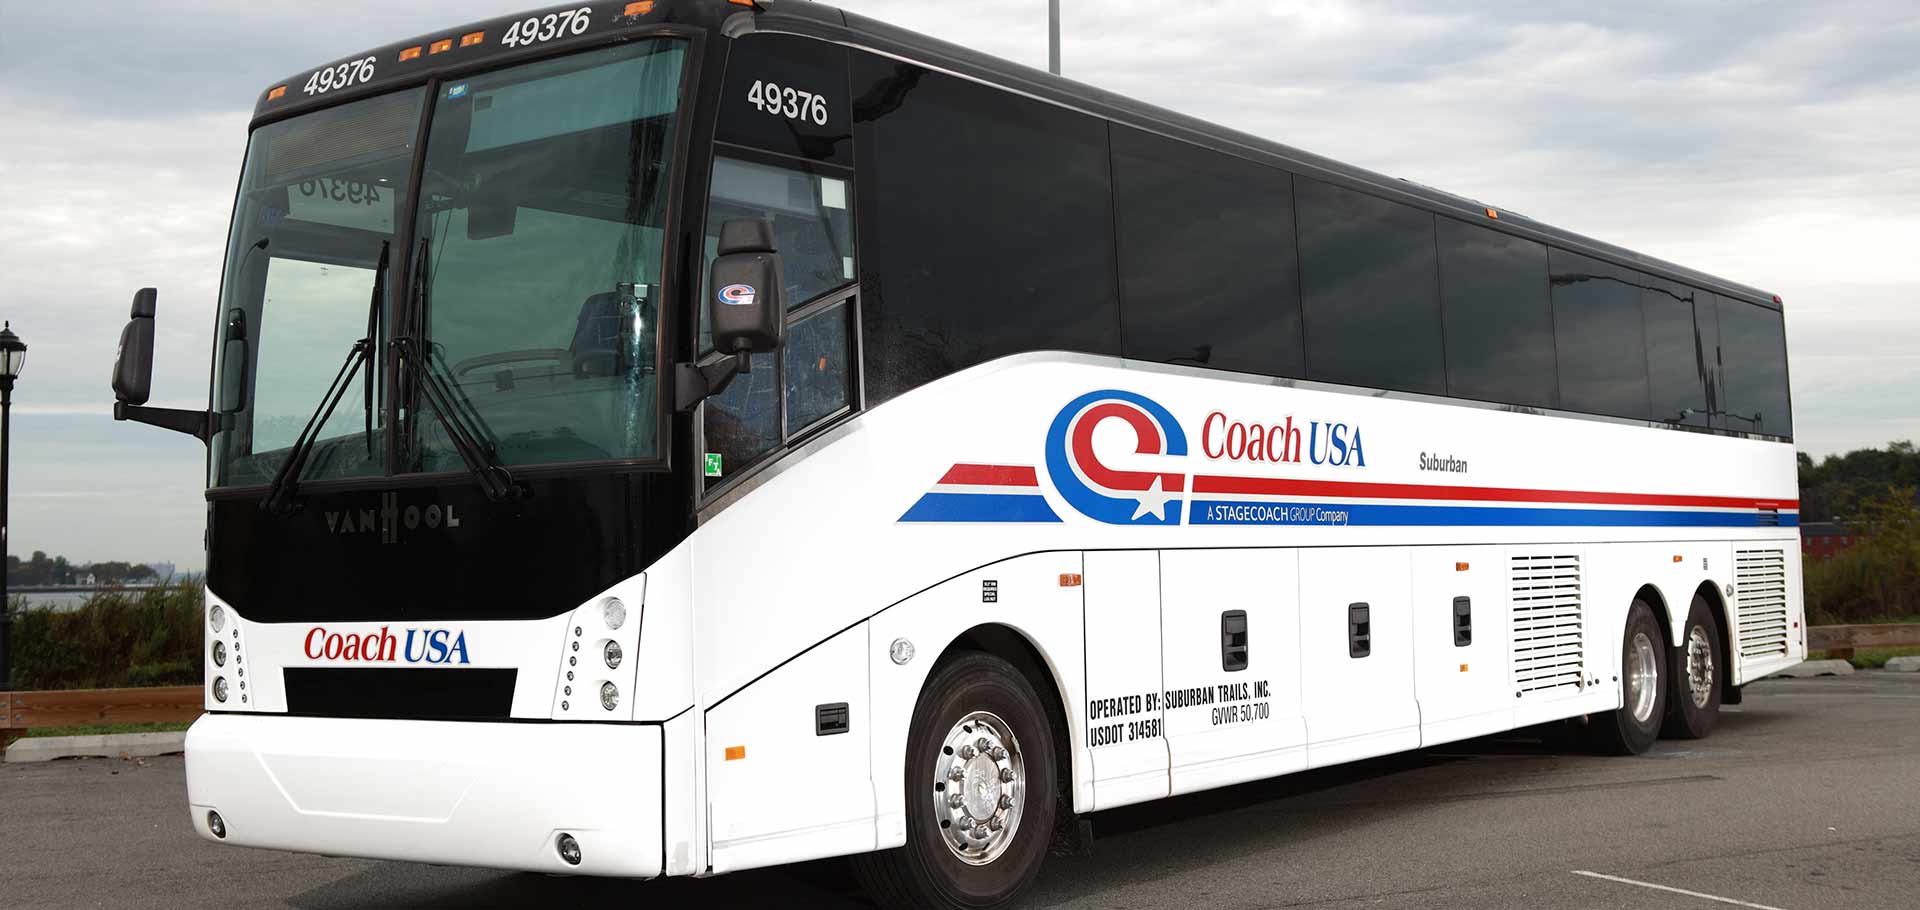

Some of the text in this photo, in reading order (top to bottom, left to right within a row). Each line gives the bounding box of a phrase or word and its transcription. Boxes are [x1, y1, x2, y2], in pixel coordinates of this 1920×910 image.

[501, 7, 592, 48] 49376
[303, 56, 377, 96] 49376
[747, 79, 828, 126] 49376
[1201, 411, 1366, 467] Coach USA
[1419, 451, 1467, 473] Suburban
[1207, 505, 1349, 526] A STAGECOACH GROUP Company
[304, 626, 470, 664] Coach USA
[1090, 680, 1271, 720] OPERATED BY: SUBURBAN TRAILS, INC.
[1211, 702, 1270, 726] GVWR 50,700
[1090, 718, 1162, 747] USDOT 314581
